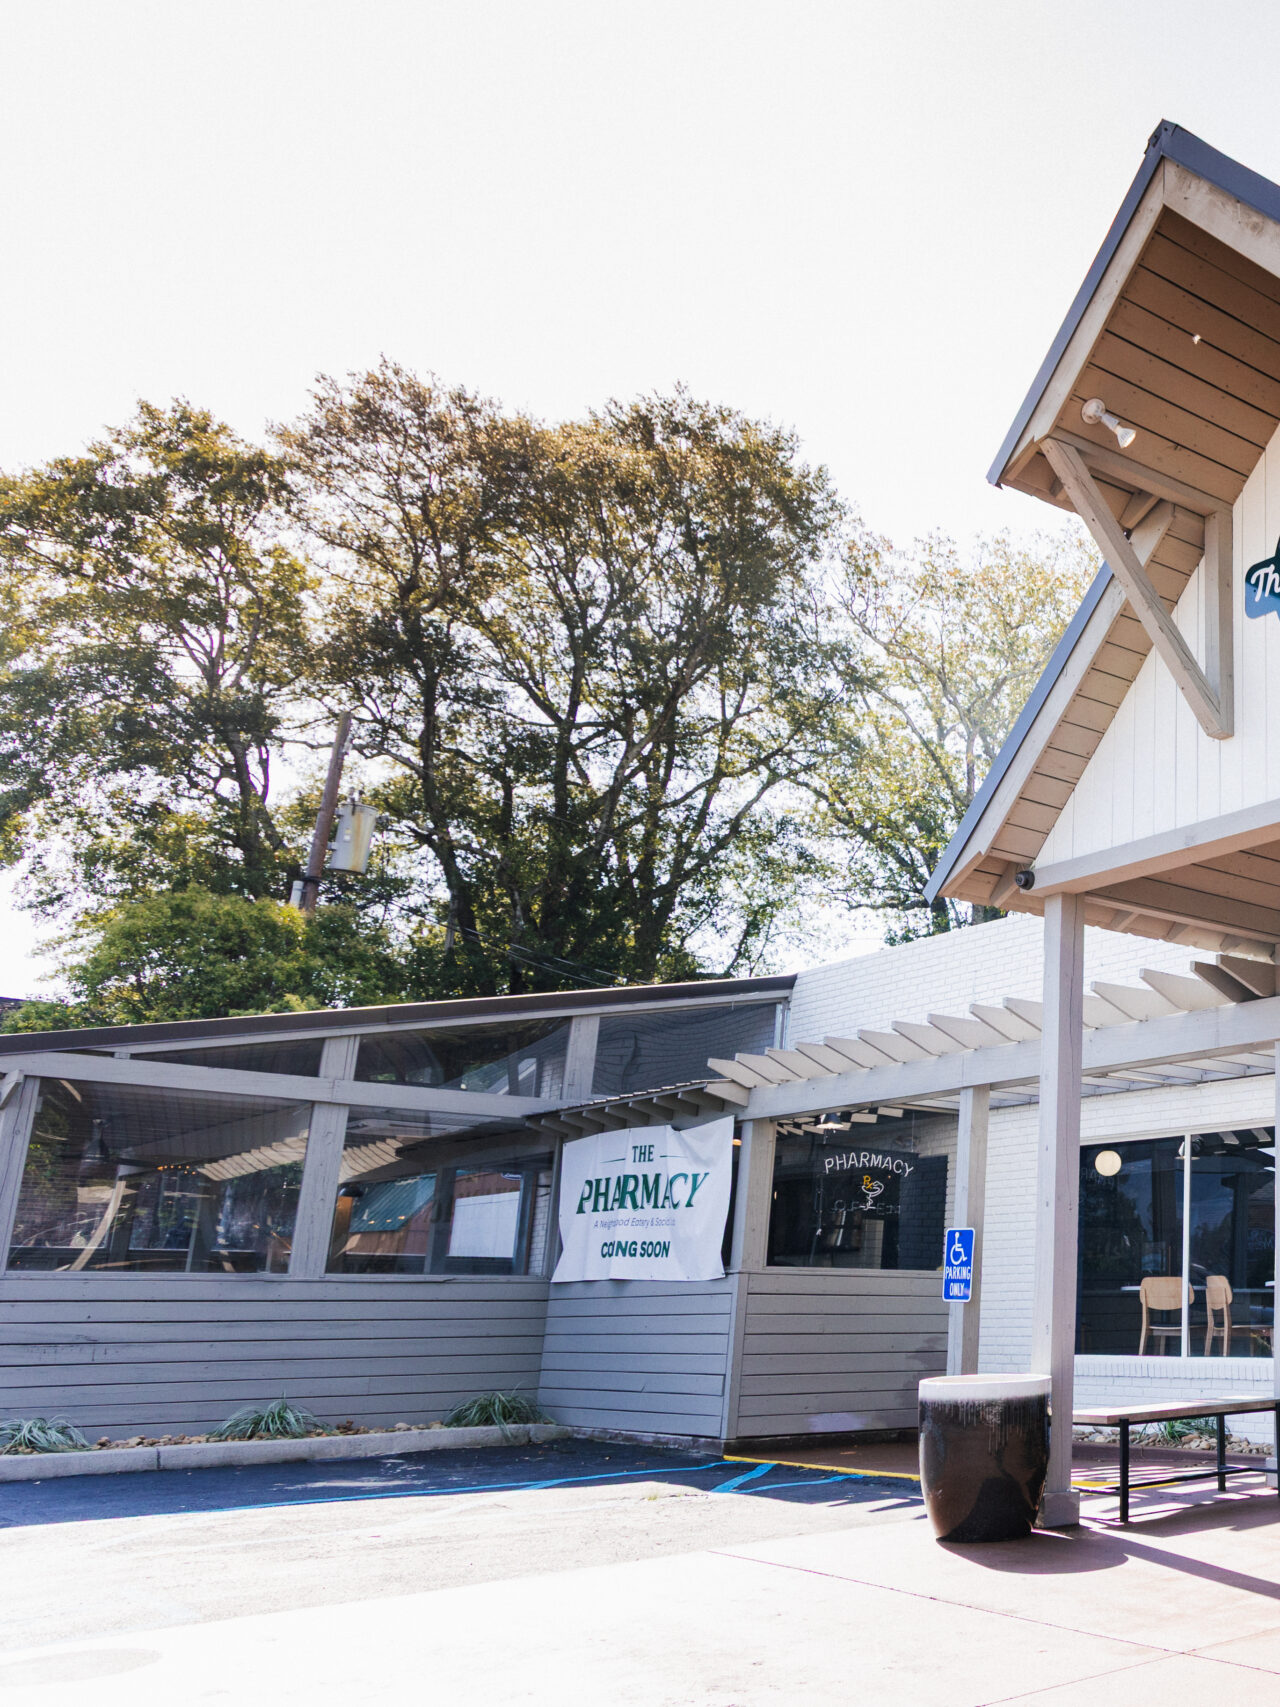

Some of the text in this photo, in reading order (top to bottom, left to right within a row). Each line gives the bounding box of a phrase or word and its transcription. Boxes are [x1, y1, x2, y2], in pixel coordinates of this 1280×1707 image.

[632, 1144, 655, 1163] THE
[824, 1152, 914, 1177] PHARMACY
[639, 1240, 671, 1258] SOON
[945, 1266, 971, 1280] PARKING
[949, 1282, 965, 1296] ONLY
